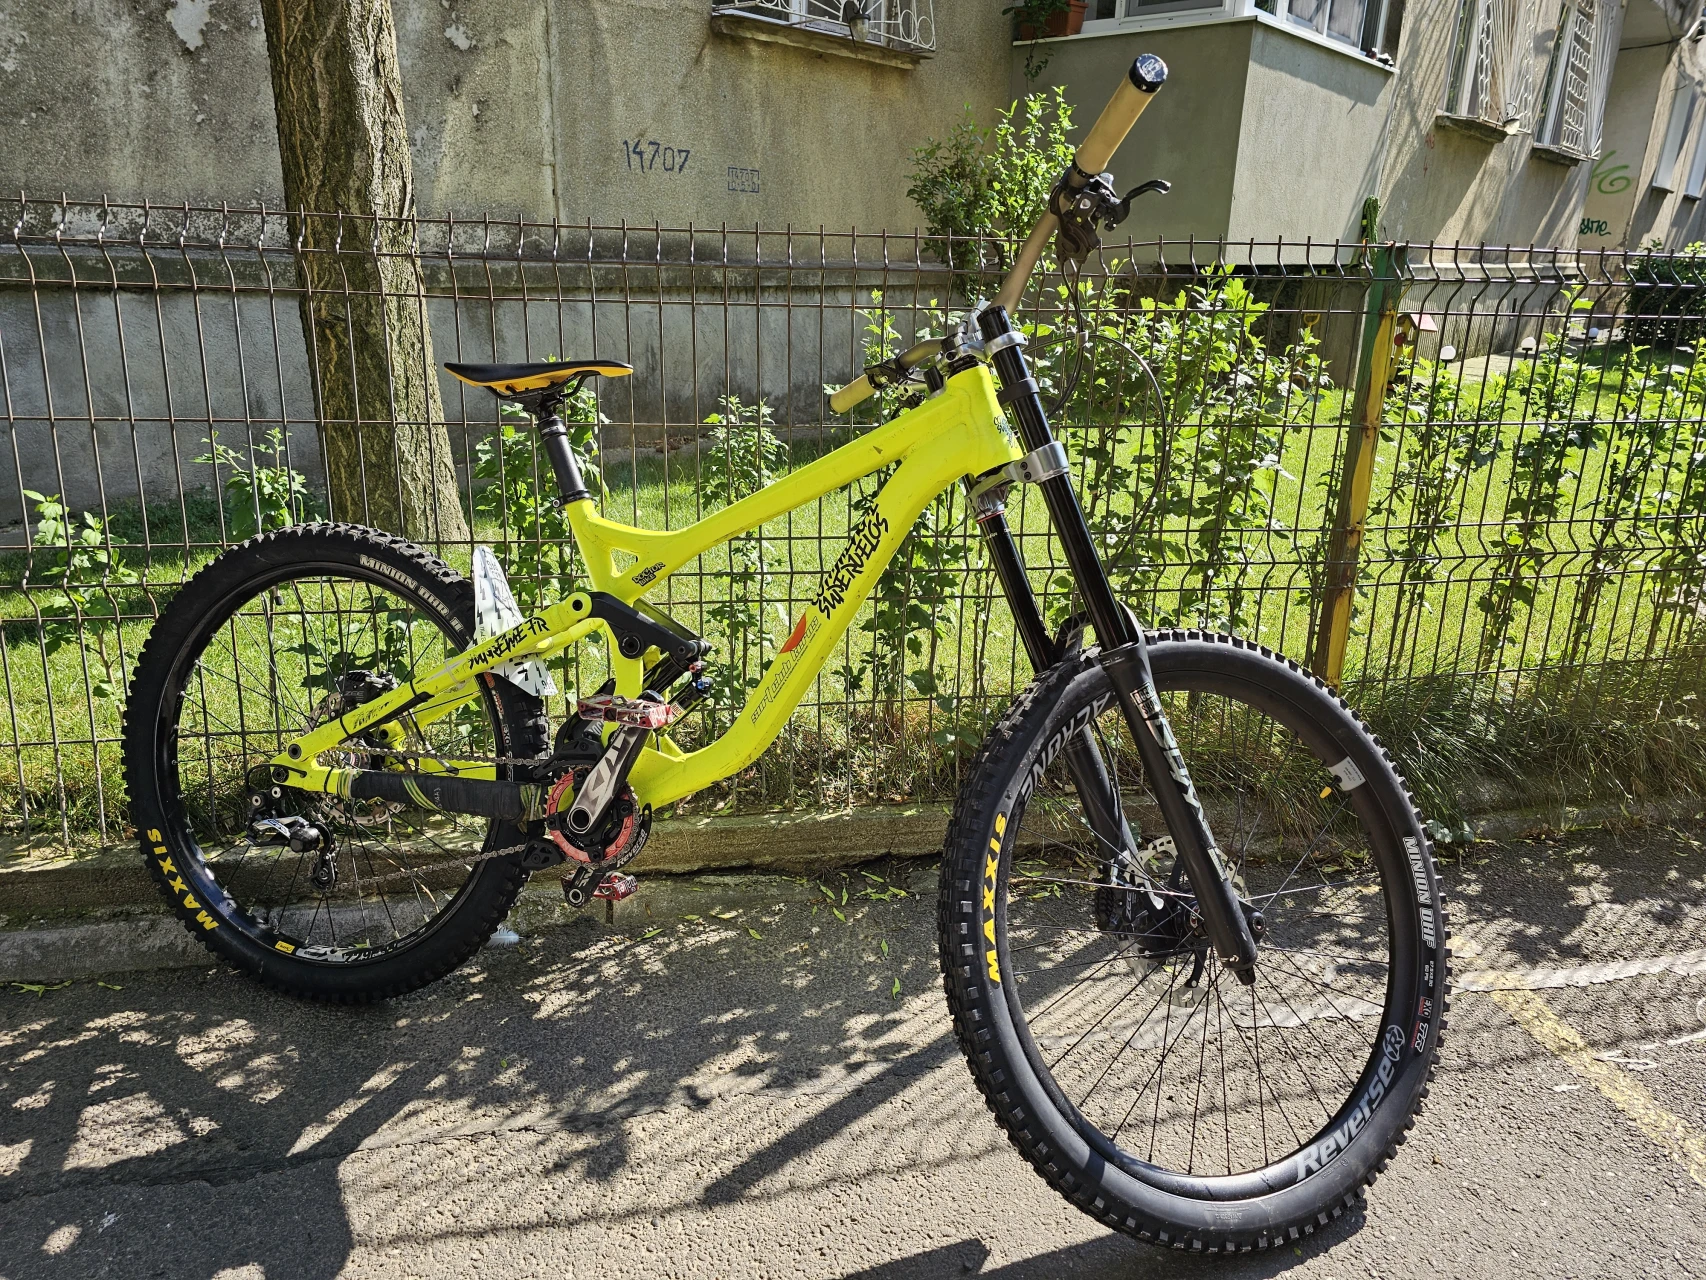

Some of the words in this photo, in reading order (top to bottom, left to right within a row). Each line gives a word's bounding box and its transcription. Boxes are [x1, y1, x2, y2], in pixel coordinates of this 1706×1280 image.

[623, 139, 691, 174] 14707
[359, 553, 418, 591] MINION
[418, 586, 450, 618] DHR
[631, 562, 666, 585] DOCTOR
[639, 573, 657, 587] BIKE
[617, 830, 647, 868] Reverse
[147, 829, 220, 931] MAXXIS
[982, 813, 1008, 983] MAXXIS
[1403, 836, 1432, 905] MINION
[1420, 907, 1436, 949] DHF
[1422, 997, 1433, 1018] EXO
[1296, 1060, 1396, 1183] Reverse
